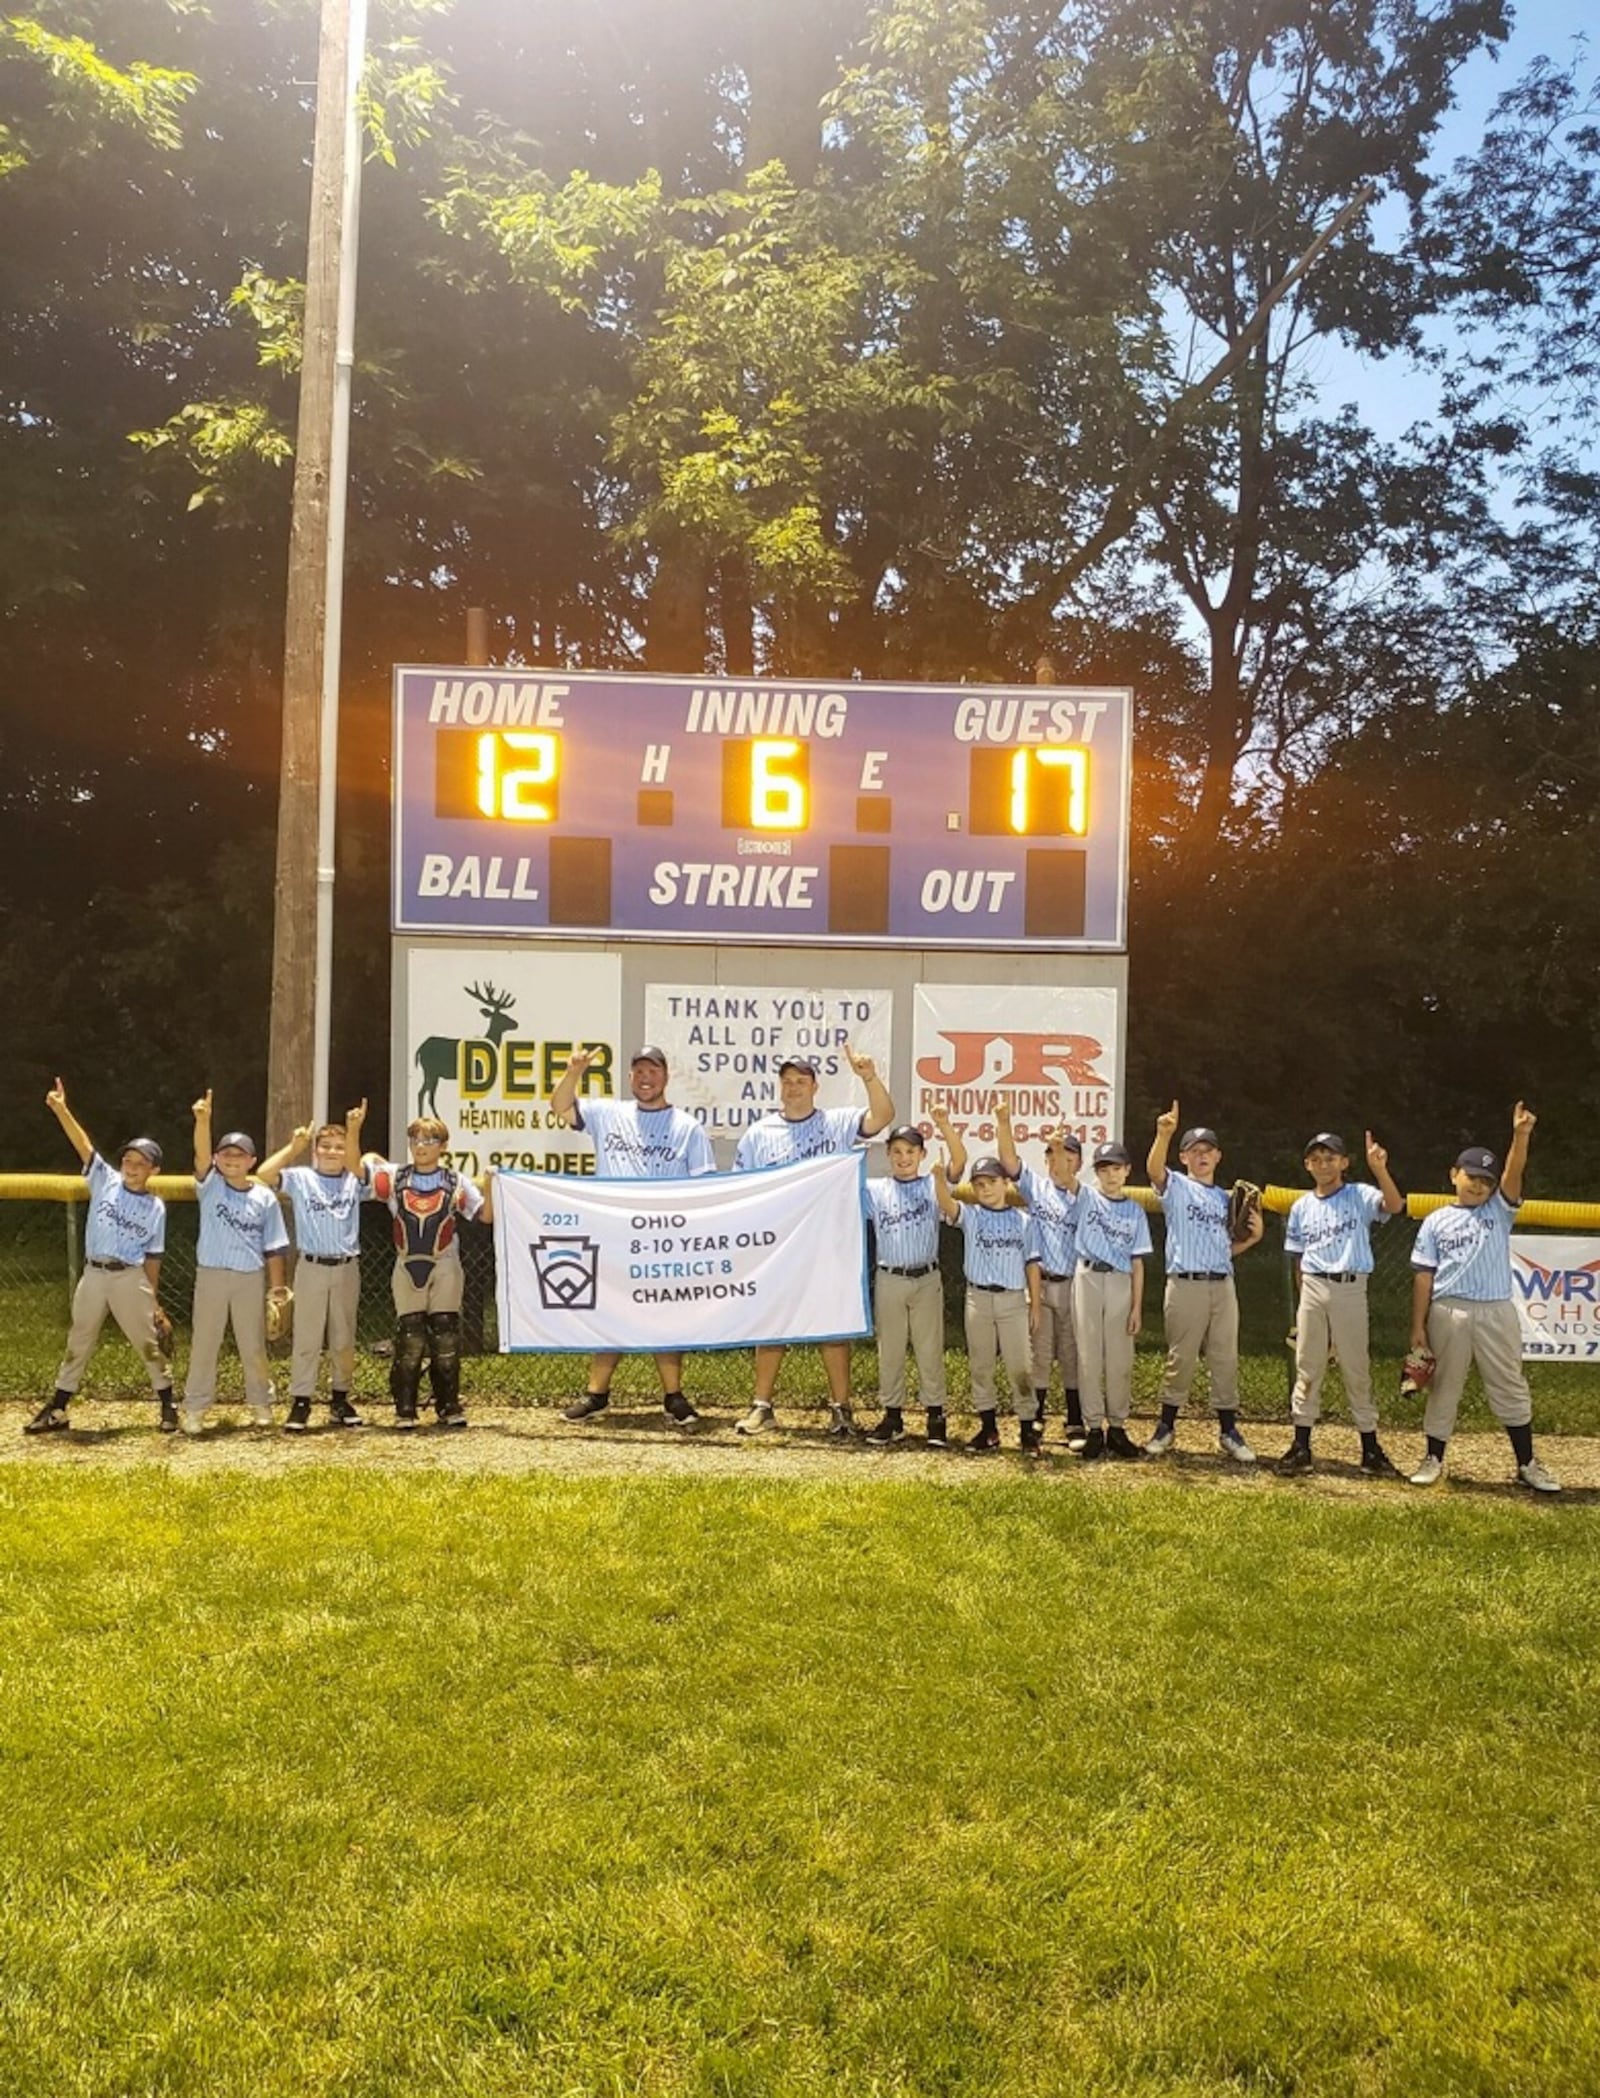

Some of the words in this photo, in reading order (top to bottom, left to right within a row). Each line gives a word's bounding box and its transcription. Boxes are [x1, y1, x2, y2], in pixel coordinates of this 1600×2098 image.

[428, 680, 570, 728] HOME
[685, 690, 848, 738] INNING
[954, 698, 1107, 743] GUEST
[476, 732, 559, 820] 12
[641, 745, 671, 783] H
[860, 751, 888, 790] E
[751, 739, 807, 829] 6
[1009, 747, 1088, 835] 17
[417, 854, 539, 900] BALL
[649, 862, 818, 908] STRIKE
[920, 869, 1015, 913] OUT
[667, 997, 759, 1018] THANK
[773, 1000, 824, 1020] YOU
[839, 1002, 871, 1022] TO
[688, 1025, 736, 1046] ALL
[751, 1027, 783, 1047] OF
[796, 1028, 849, 1047] OUR
[459, 1039, 614, 1101] DEER
[916, 1031, 1111, 1086] JR
[741, 1081, 775, 1100] AN
[1075, 1091, 1108, 1117] LLC
[459, 1109, 525, 1130] HEATING
[530, 1110, 541, 1130] &
[542, 1213, 580, 1227] 2021
[631, 1214, 687, 1230] OHIO
[630, 1238, 673, 1254] 8-10
[680, 1235, 732, 1252] YEAR
[736, 1231, 776, 1248] OLD
[630, 1261, 715, 1280] DISTRICT
[721, 1259, 733, 1274] 8
[632, 1281, 757, 1304] CHAMPIONS
